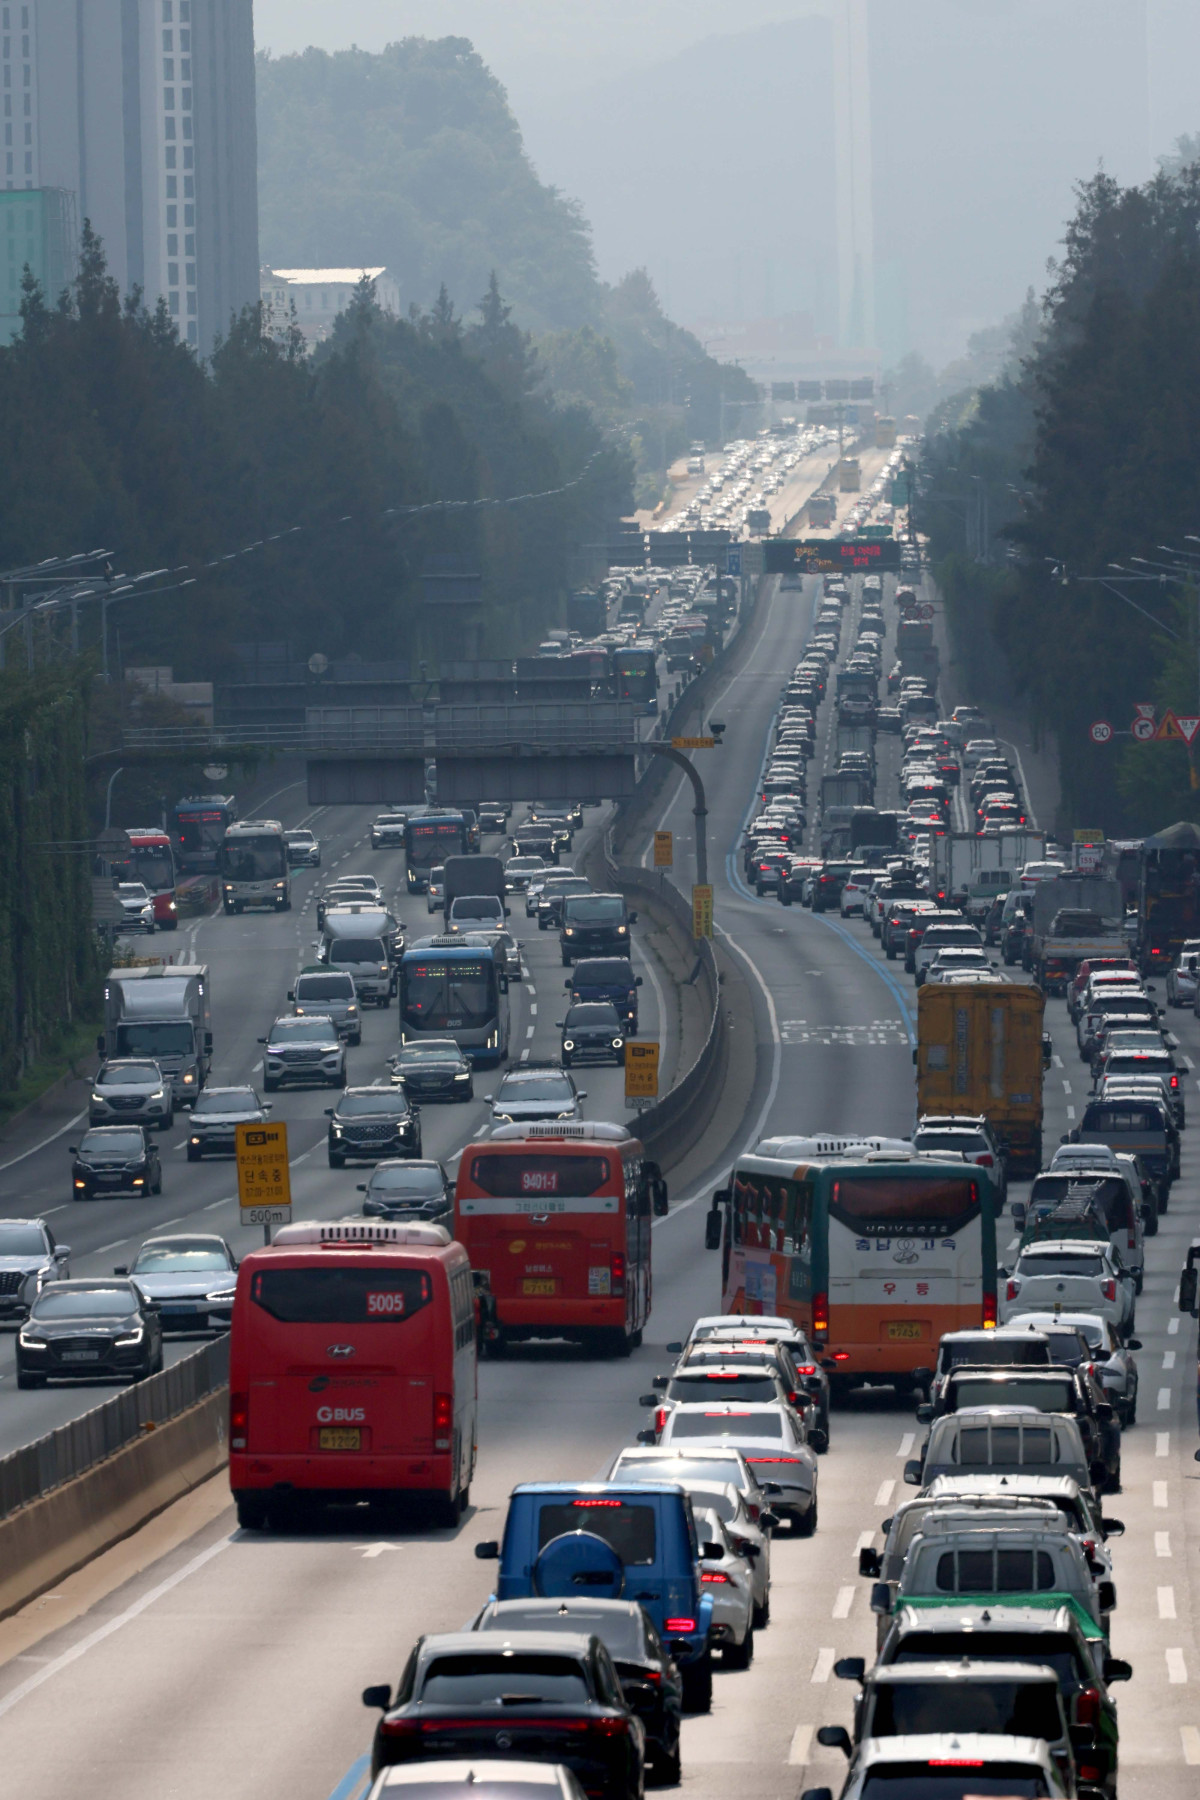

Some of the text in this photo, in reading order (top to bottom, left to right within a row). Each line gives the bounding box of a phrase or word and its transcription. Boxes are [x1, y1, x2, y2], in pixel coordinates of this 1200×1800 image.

[1094, 726, 1109, 738] 80
[523, 1173, 557, 1190] 9401-1
[250, 1209, 283, 1223] 500m
[866, 1225, 948, 1233] UNIVERSE
[921, 1238, 957, 1251] 고속
[368, 1294, 404, 1312] 5005
